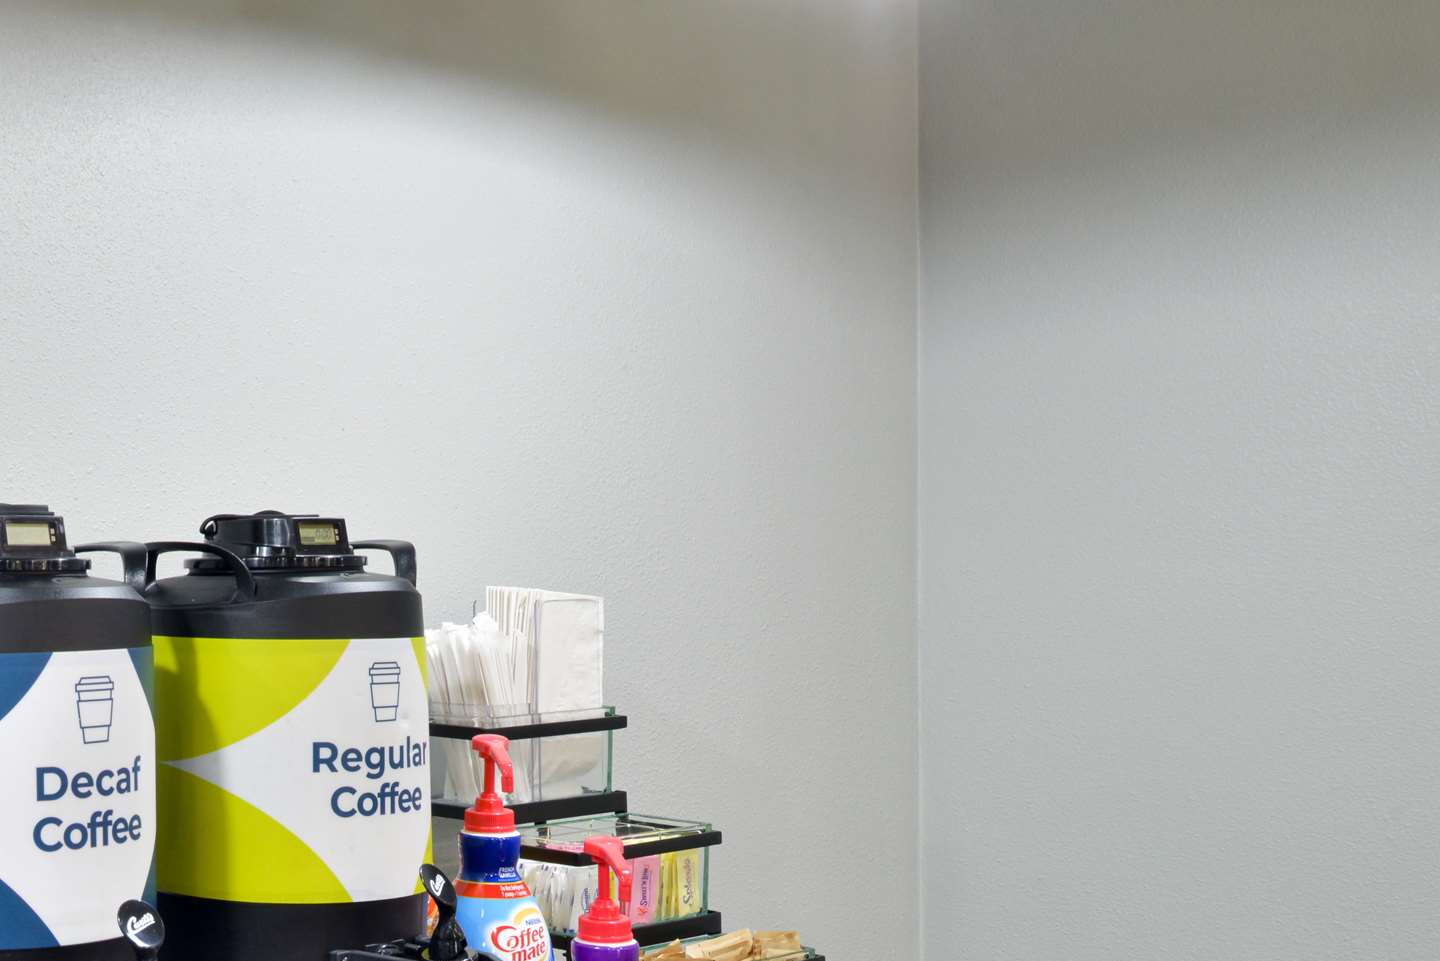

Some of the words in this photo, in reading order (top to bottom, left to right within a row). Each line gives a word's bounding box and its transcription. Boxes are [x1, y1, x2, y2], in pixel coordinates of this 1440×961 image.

[36, 755, 141, 802] Decaf
[312, 736, 426, 779] Regular
[330, 782, 422, 817] Coffee
[33, 809, 141, 852] Coffee
[491, 925, 544, 953] Coffee
